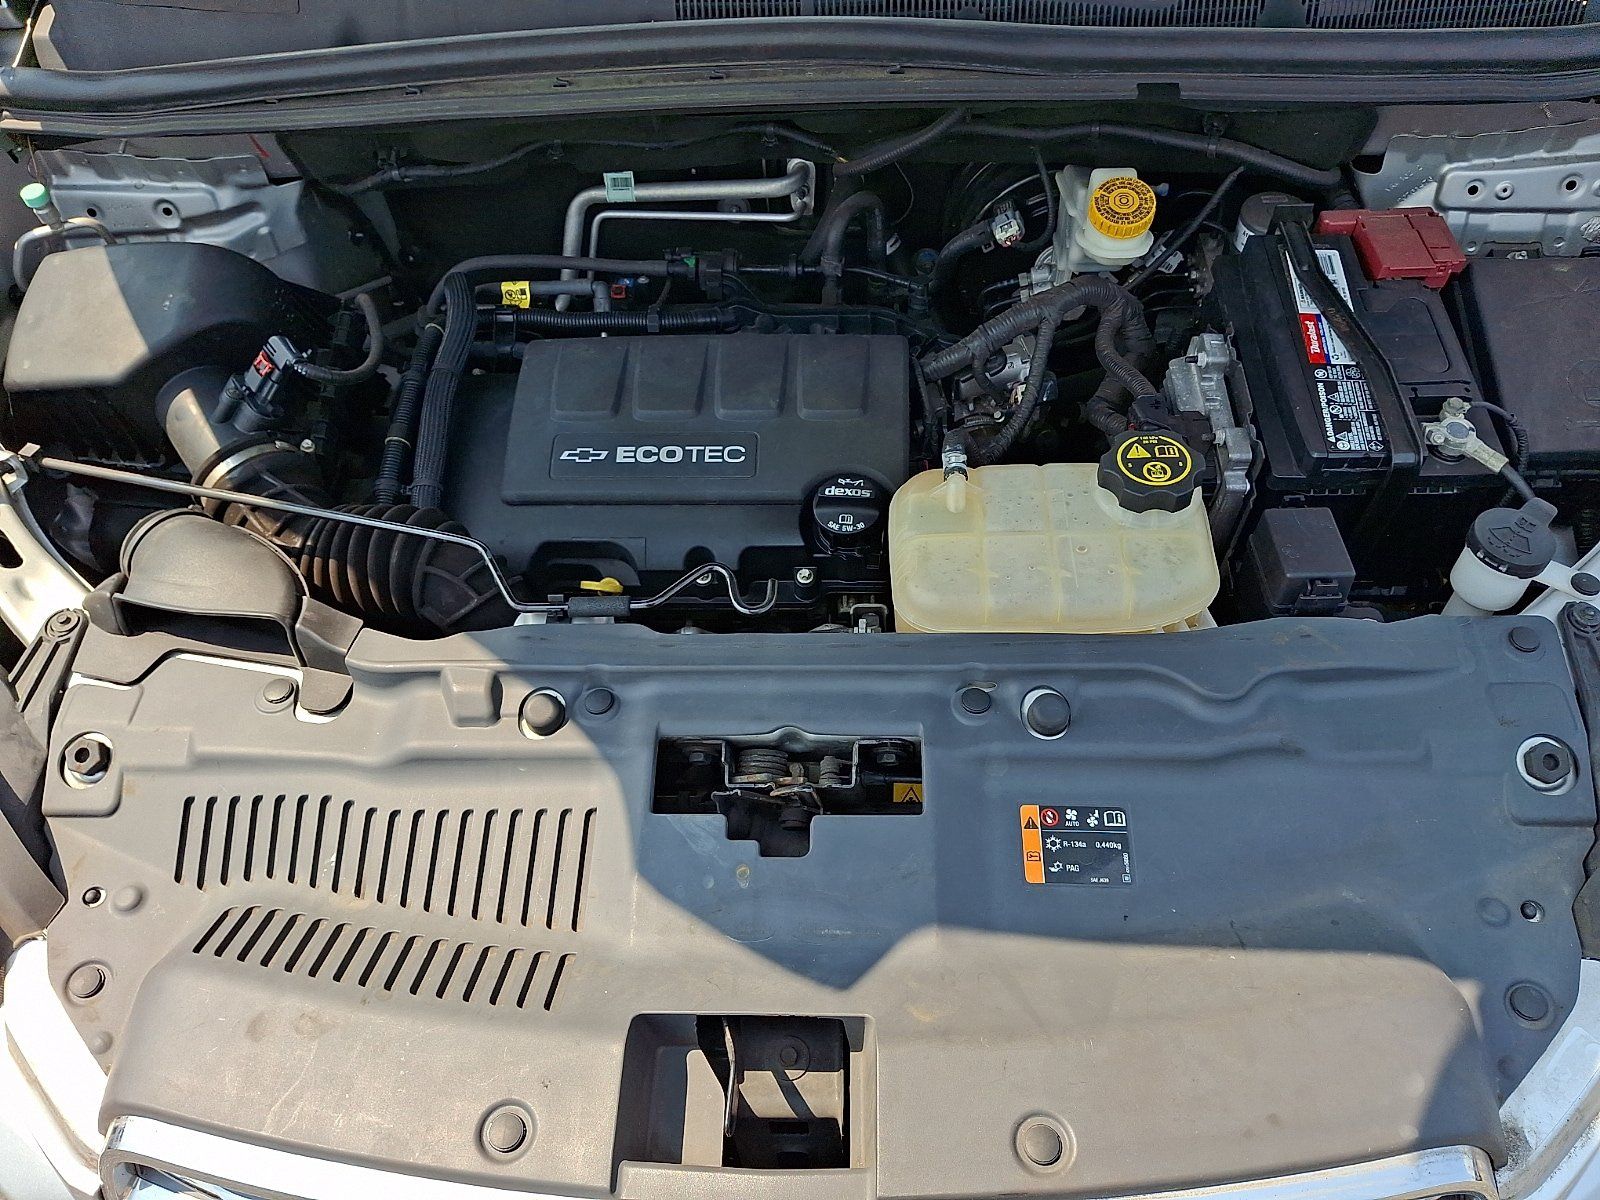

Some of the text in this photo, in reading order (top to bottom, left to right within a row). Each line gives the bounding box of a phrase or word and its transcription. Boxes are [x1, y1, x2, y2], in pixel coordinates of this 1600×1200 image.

[1304, 320, 1320, 354] Duralast
[615, 445, 746, 463] ECOTEC
[824, 485, 873, 498] dexos
[827, 521, 866, 532] SAE 5W-30
[1062, 840, 1122, 850] R-134a 0.440kg
[1065, 864, 1080, 873] PAG
